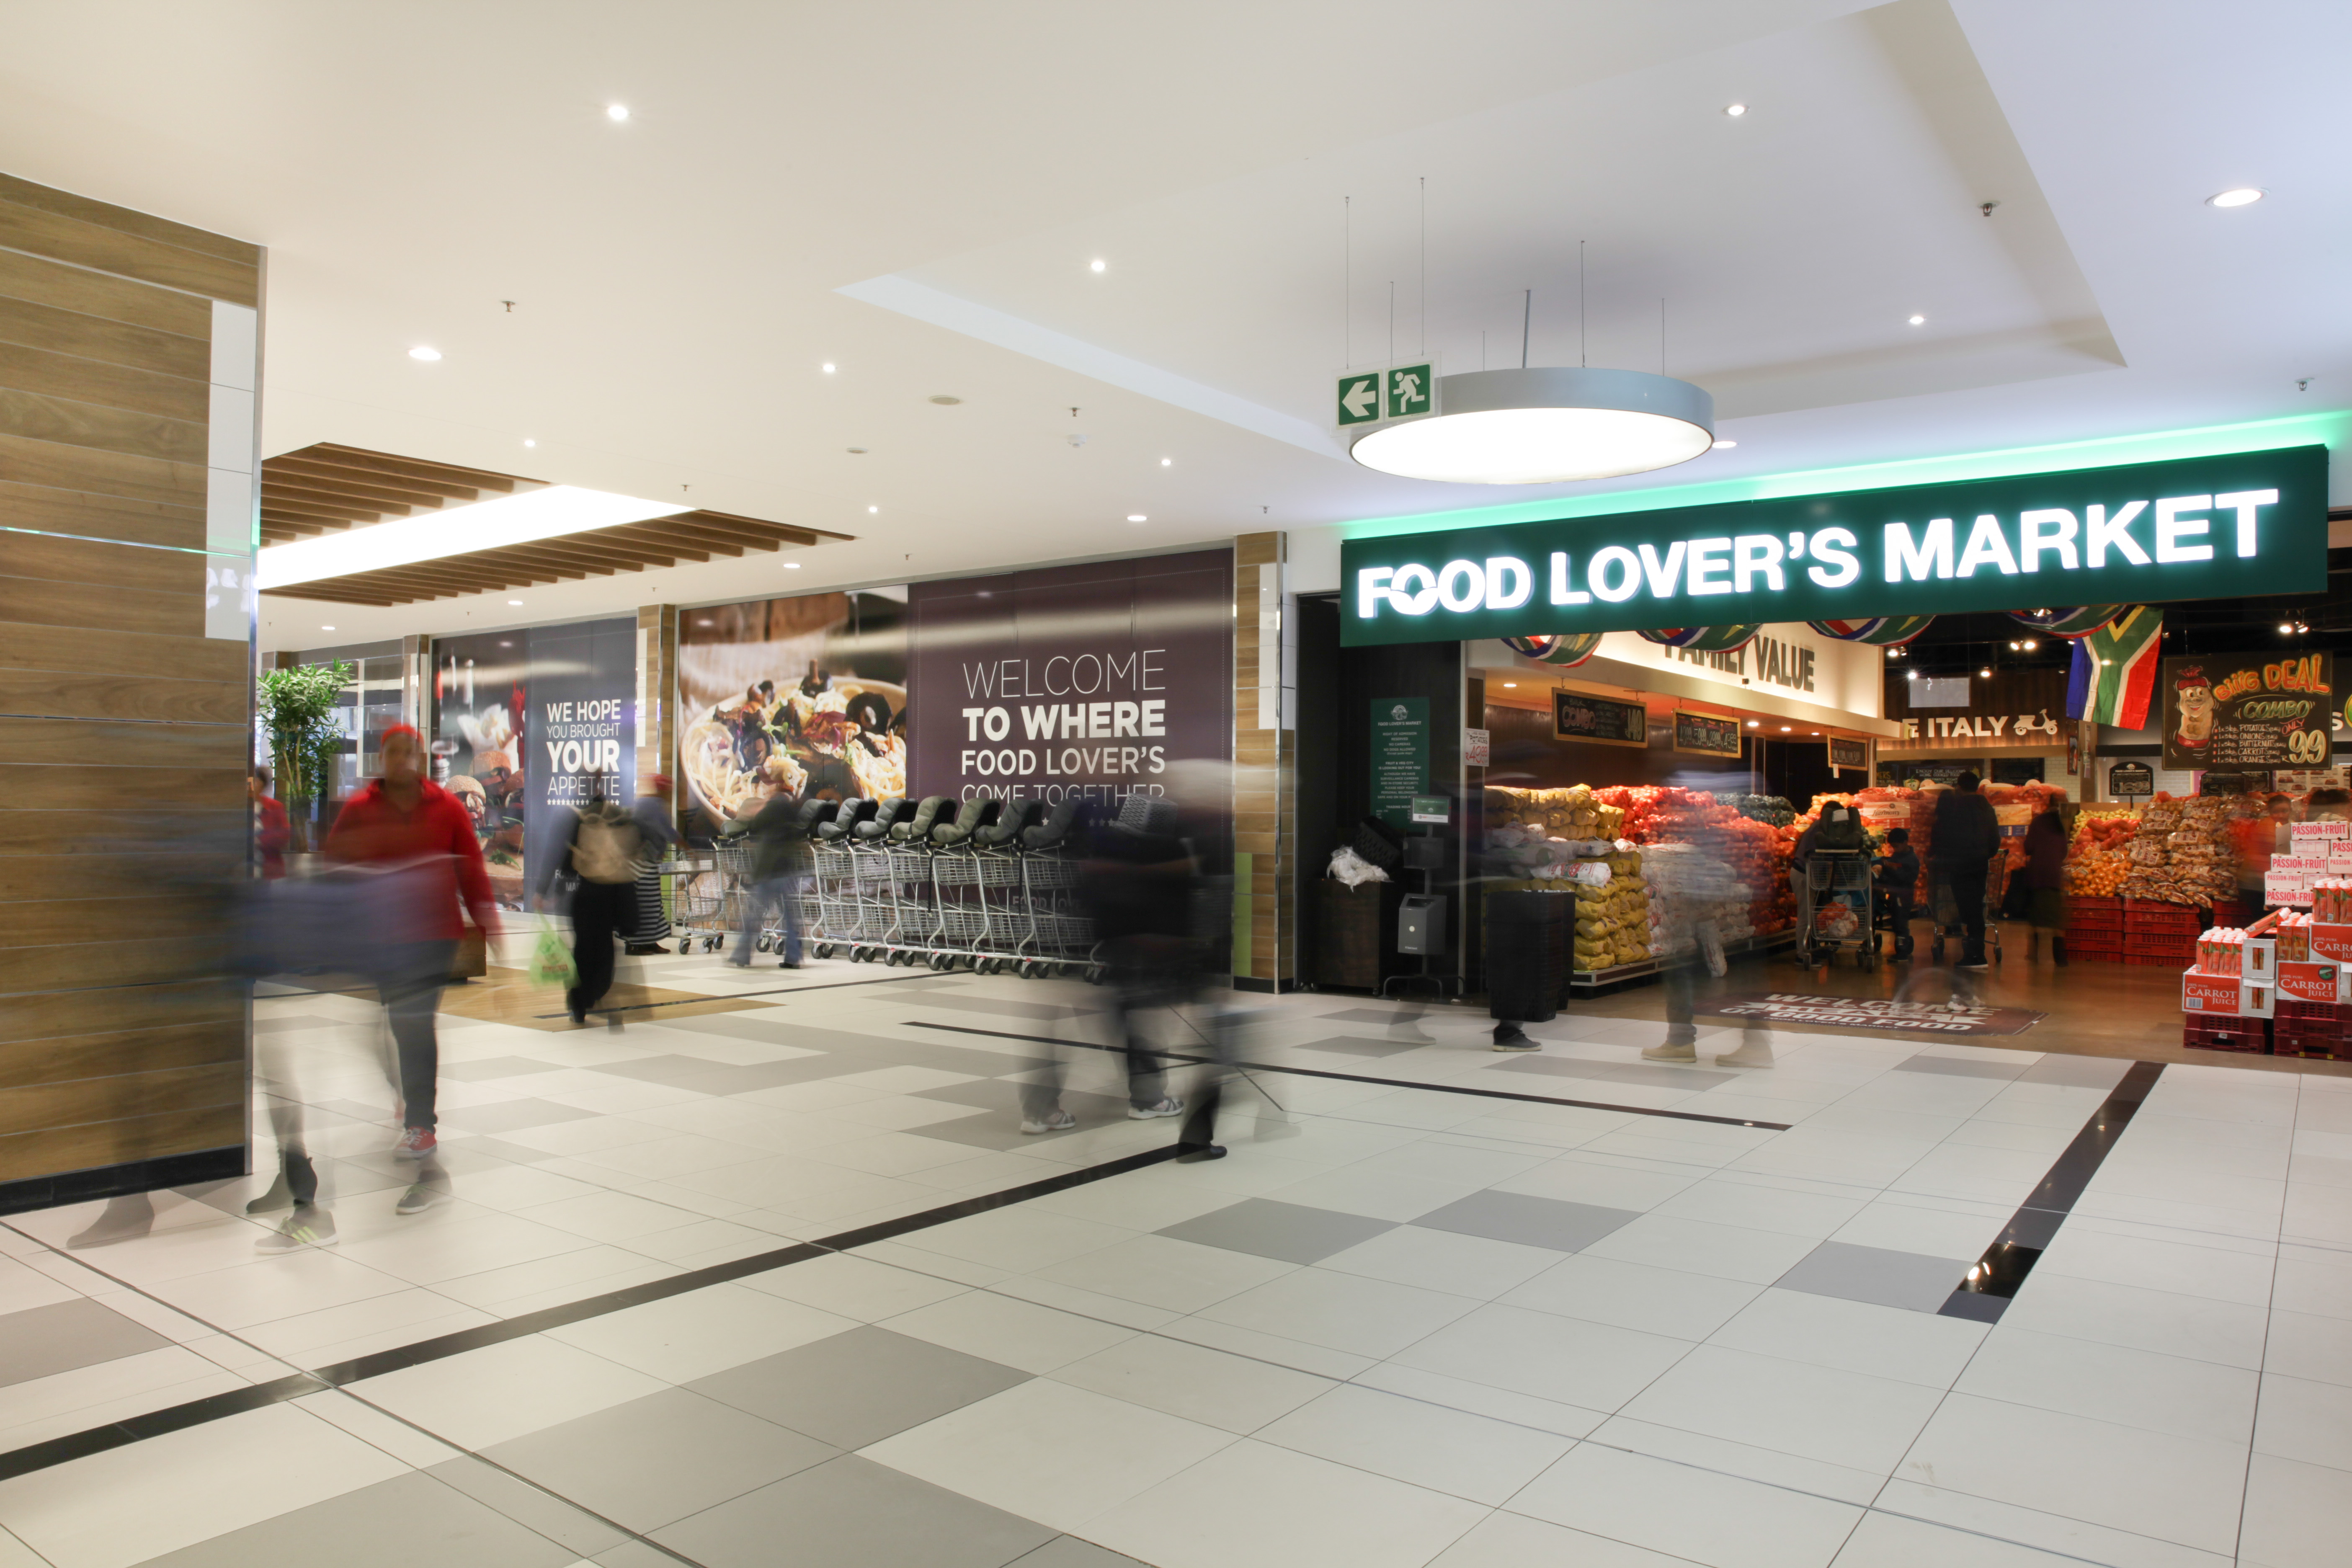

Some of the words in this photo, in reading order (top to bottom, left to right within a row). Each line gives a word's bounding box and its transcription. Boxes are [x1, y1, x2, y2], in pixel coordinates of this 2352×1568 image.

[1358, 556, 1532, 619] FOOD
[1550, 527, 1859, 606] LOVER'S
[1884, 489, 2278, 582] MARKET
[1754, 634, 1815, 693] VALUE
[963, 650, 1166, 699] WELCOME
[2263, 653, 2330, 694] DEAL
[547, 702, 572, 722] WE
[577, 699, 621, 721] HOPE
[1562, 705, 1596, 730] COMBO
[2243, 700, 2310, 719] COMBO
[962, 707, 1010, 741] TO
[1021, 699, 1166, 740] WHERE
[1928, 716, 2009, 737] ITALY
[2281, 719, 2305, 735] ONLY
[547, 725, 567, 738] YOU
[570, 723, 621, 738] BROUGHT
[546, 739, 620, 773] YOUR
[962, 749, 1037, 775] FOOD
[1046, 746, 1166, 775] LOVER'S
[2238, 747, 2269, 756] CARROTS
[2292, 825, 2346, 835] PASSION-FRUIT
[2272, 859, 2326, 869] PASSION-FRUIT
[2267, 891, 2313, 902] PASSION-FRU
[2314, 941, 2352, 952] CARR
[2187, 987, 2237, 999] CARROT
[2280, 979, 2334, 990] CARROT
[1770, 1012, 1867, 1023] GOOD
[1872, 1019, 1972, 1030] FOOD
